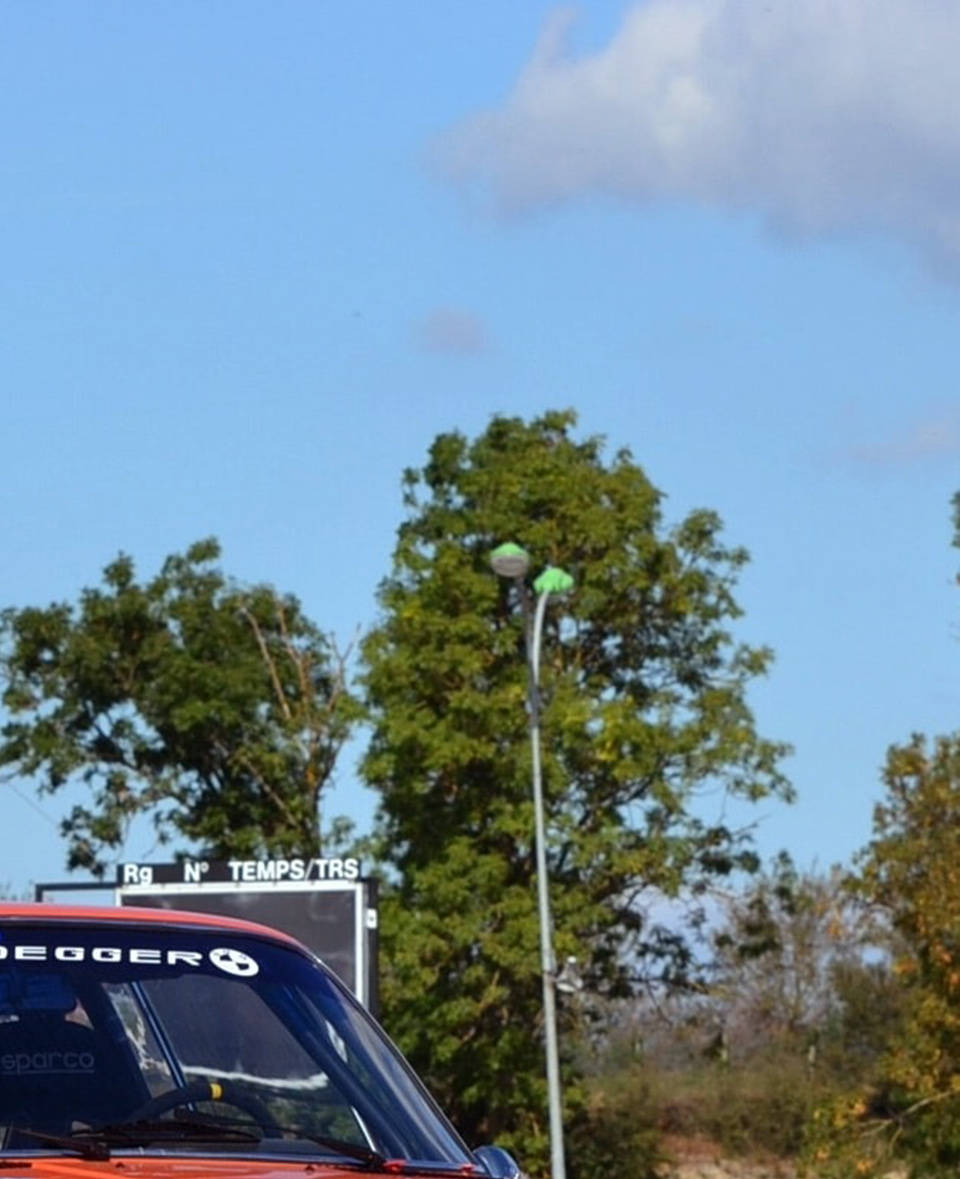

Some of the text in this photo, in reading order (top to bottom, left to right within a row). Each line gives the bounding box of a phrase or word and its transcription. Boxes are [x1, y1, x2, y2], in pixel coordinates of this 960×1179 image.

[123, 864, 153, 884] Rg
[229, 859, 359, 880] TEMPS/TRS
[1, 1052, 95, 1074] sparco
